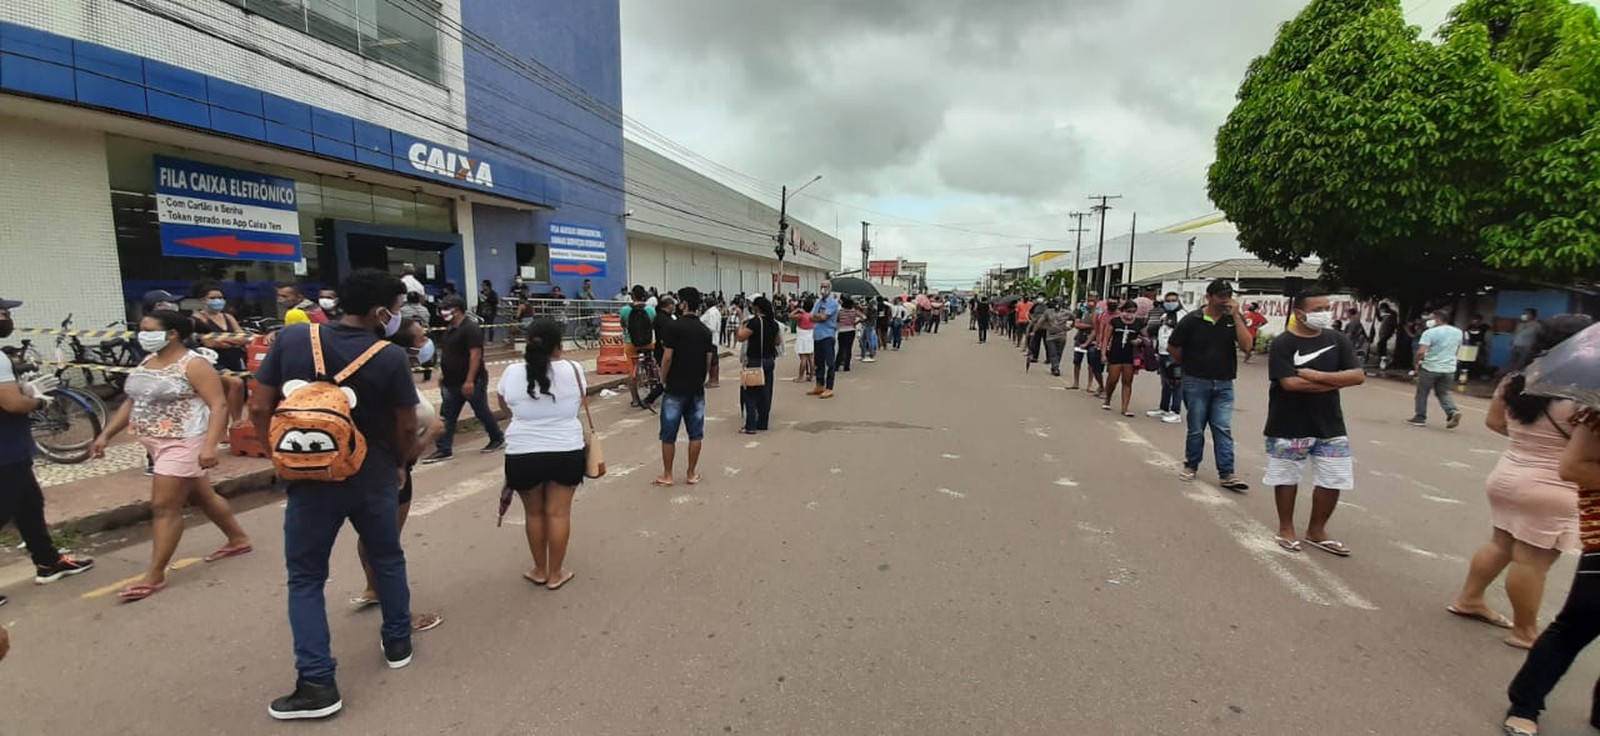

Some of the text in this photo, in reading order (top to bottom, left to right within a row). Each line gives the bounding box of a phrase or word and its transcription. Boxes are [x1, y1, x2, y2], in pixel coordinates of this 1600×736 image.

[408, 142, 494, 188] CAIXA
[160, 167, 294, 204] FILA CAIXA ELETRÔNICO
[166, 197, 186, 208] Com
[187, 199, 213, 212] Cartão
[214, 204, 219, 212] e
[221, 204, 243, 215] Senha
[193, 214, 220, 225] gerado
[222, 217, 232, 225] no
[233, 217, 247, 228] App
[248, 219, 267, 230] Caixa
[268, 221, 282, 231] Tem
